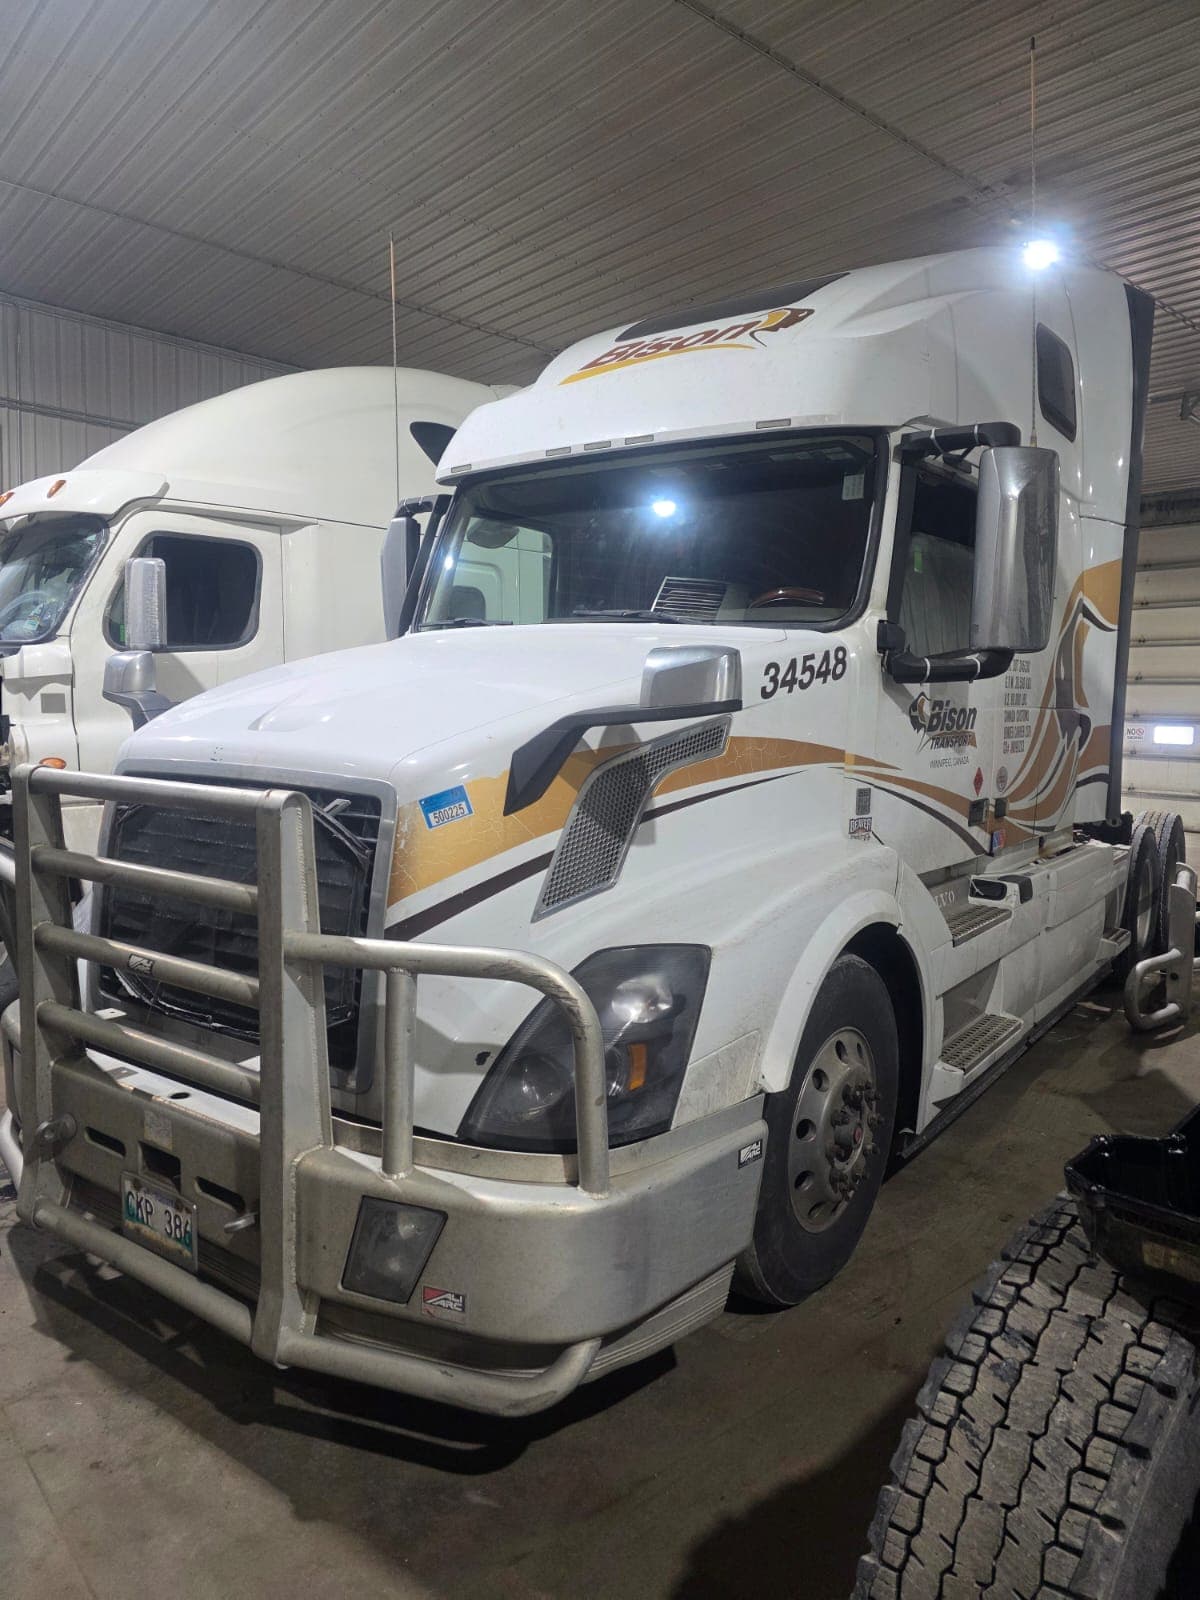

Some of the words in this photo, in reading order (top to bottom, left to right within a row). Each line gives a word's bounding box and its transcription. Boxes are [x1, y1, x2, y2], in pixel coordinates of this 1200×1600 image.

[578, 321, 761, 371] Bison
[760, 646, 847, 700] 34548
[927, 700, 977, 732] Bison
[930, 735, 970, 750] TRANSPORT
[433, 803, 465, 824] 500225
[126, 1190, 154, 1226] CKP
